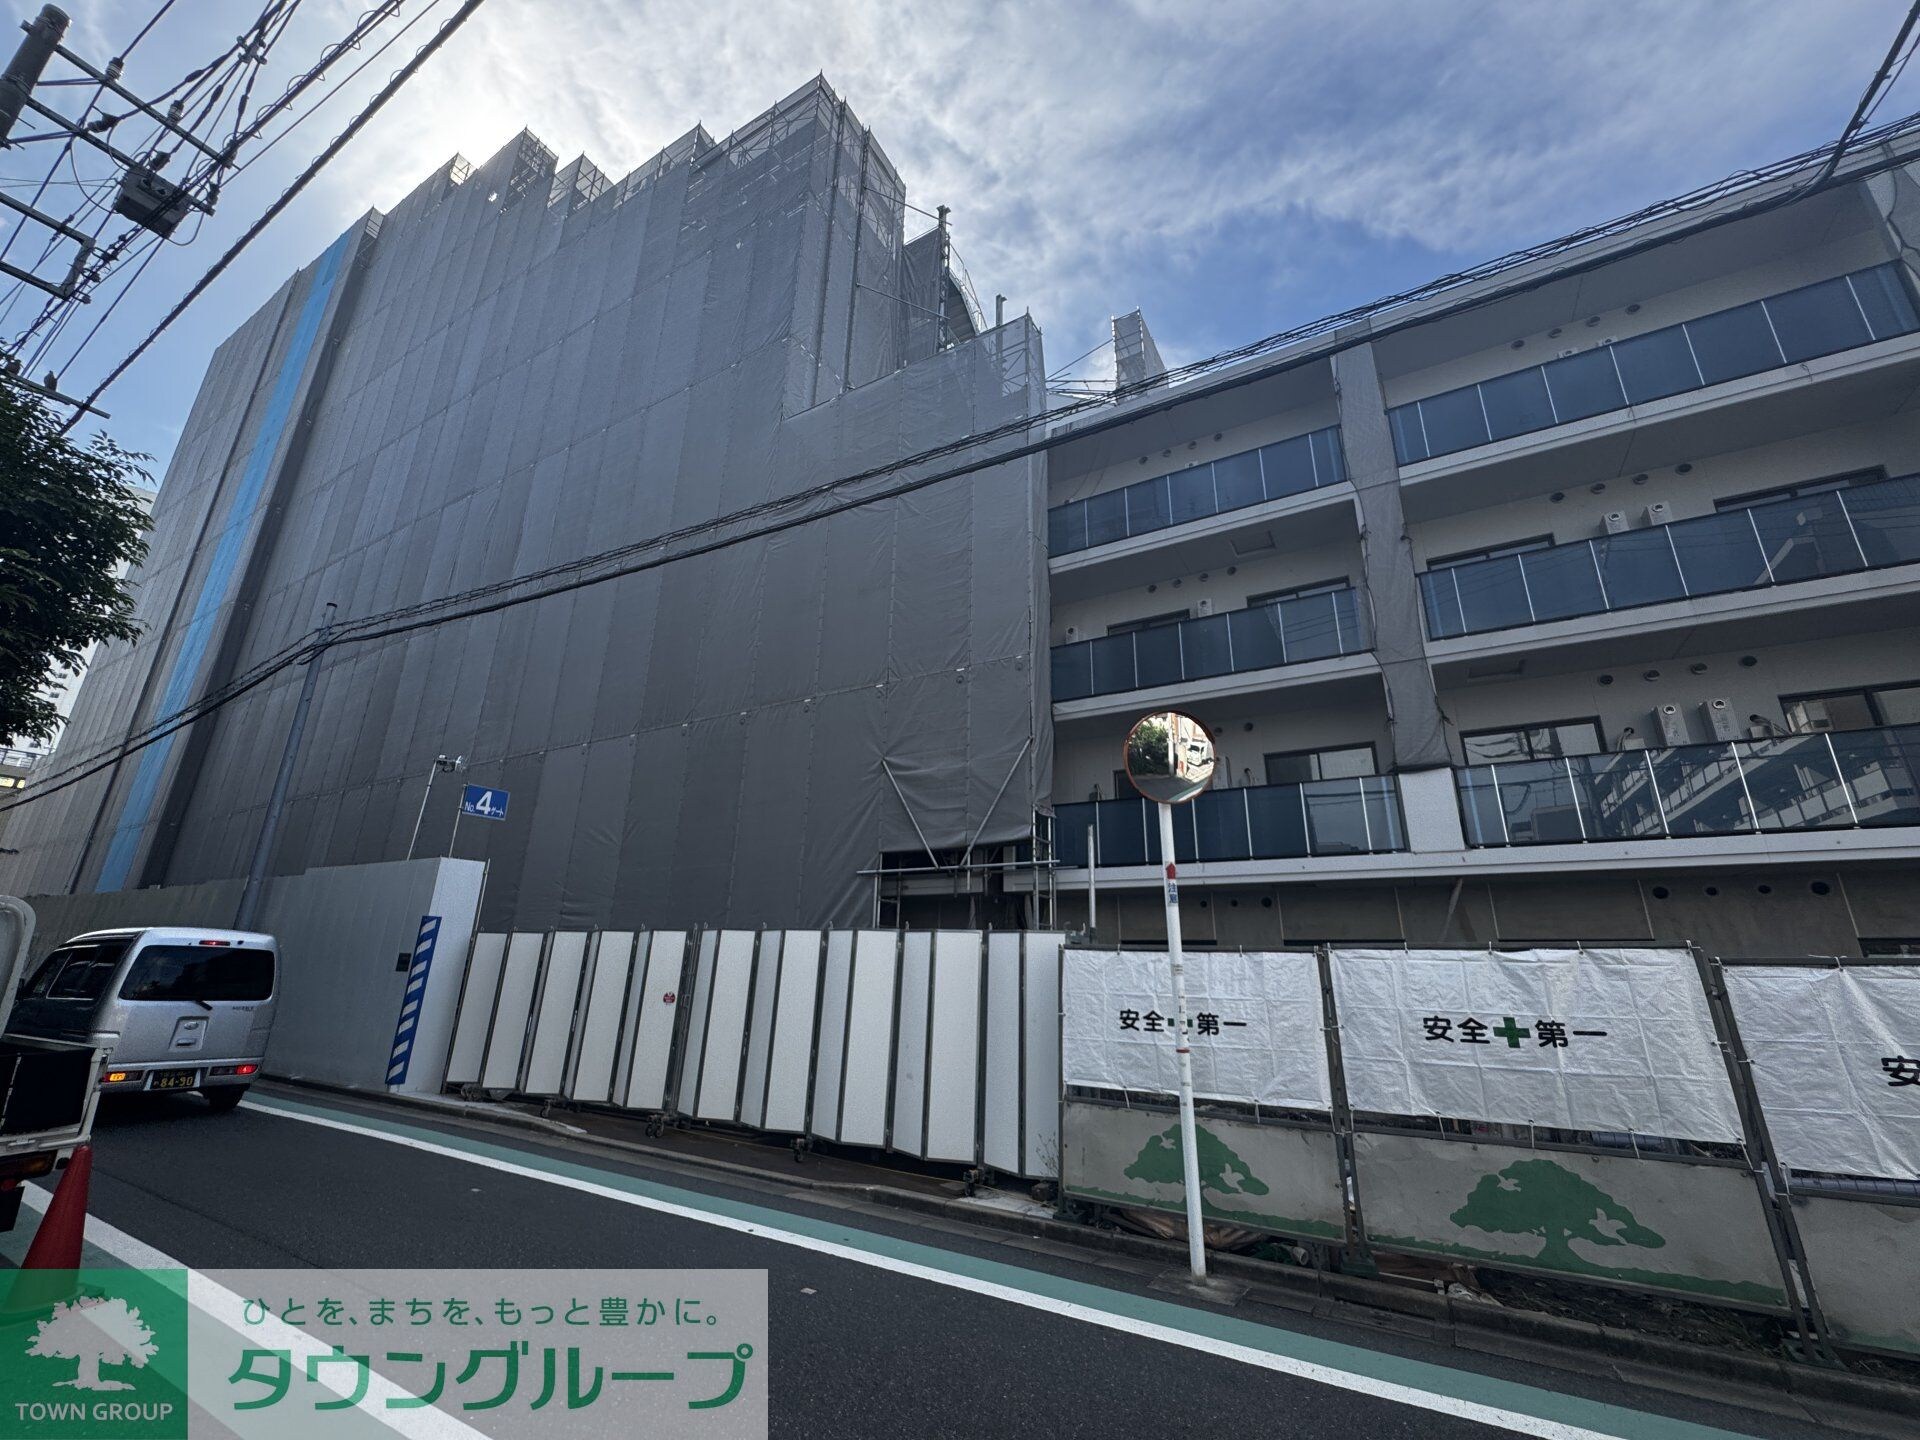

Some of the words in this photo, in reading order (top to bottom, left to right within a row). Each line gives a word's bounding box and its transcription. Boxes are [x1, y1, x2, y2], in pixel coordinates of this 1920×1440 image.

[476, 791, 492, 815] 4
[1120, 1009, 1165, 1032] 安全
[1197, 1012, 1247, 1036] 第一
[1423, 1016, 1490, 1044] 安全
[1535, 1020, 1607, 1048] 第一
